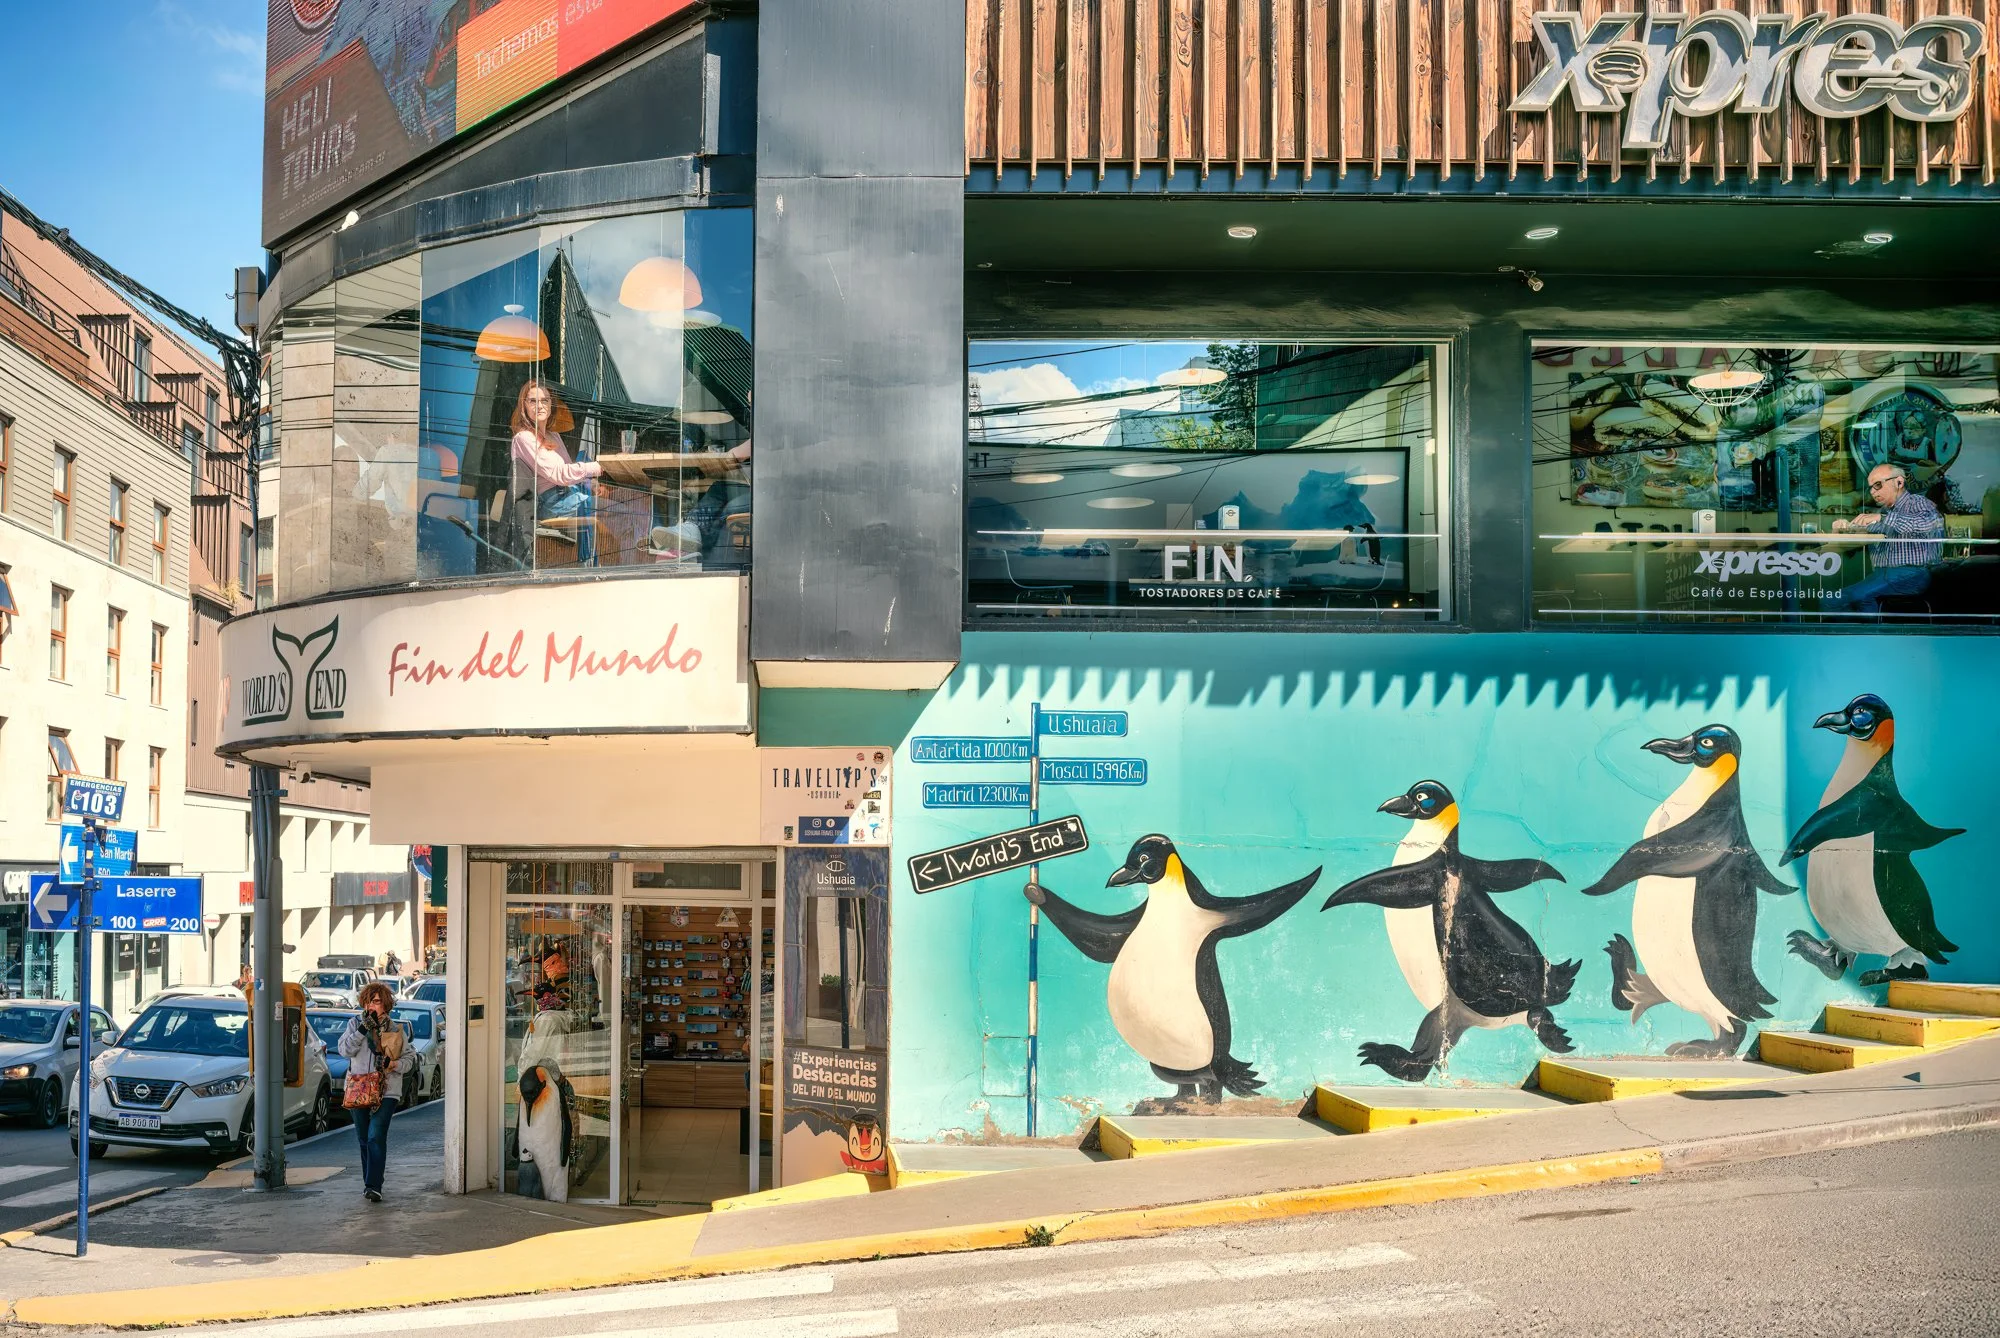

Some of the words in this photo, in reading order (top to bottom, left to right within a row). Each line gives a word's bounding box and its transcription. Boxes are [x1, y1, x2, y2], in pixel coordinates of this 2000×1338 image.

[474, 13, 558, 80] Tachemos
[281, 76, 332, 150] HELI
[282, 112, 358, 200] TOURS
[1164, 545, 1243, 582] FIN
[1139, 588, 1224, 598] TOSTADORES
[1227, 588, 1244, 598] DE
[1248, 587, 1281, 598] CAFÉ
[1690, 586, 1724, 598] Café
[1728, 587, 1745, 598] de
[1749, 587, 1843, 600] Especialidad
[388, 642, 453, 697] Fin
[457, 629, 529, 682] del
[543, 622, 703, 683] Mundo
[242, 671, 288, 718] WORLD'S
[313, 668, 347, 711] END
[1048, 715, 1117, 733] Ushuaia
[915, 742, 981, 759] Antártida
[1042, 762, 1088, 779] Moscú
[70, 780, 122, 792] EMERGENCIAS
[926, 786, 975, 803] Madrid
[82, 791, 117, 815] 103
[1029, 828, 1064, 853] End
[100, 846, 113, 859] San
[817, 872, 856, 885] Ushuaia
[116, 884, 177, 898] Laserre
[110, 915, 137, 929] 100
[169, 917, 199, 931] 200
[793, 1051, 877, 1072] #Experiencias
[792, 1064, 877, 1088] Destacadas
[792, 1083, 809, 1096] DEL
[811, 1085, 825, 1098] FIN
[827, 1087, 844, 1100] DEL
[846, 1089, 877, 1104] MUNDO
